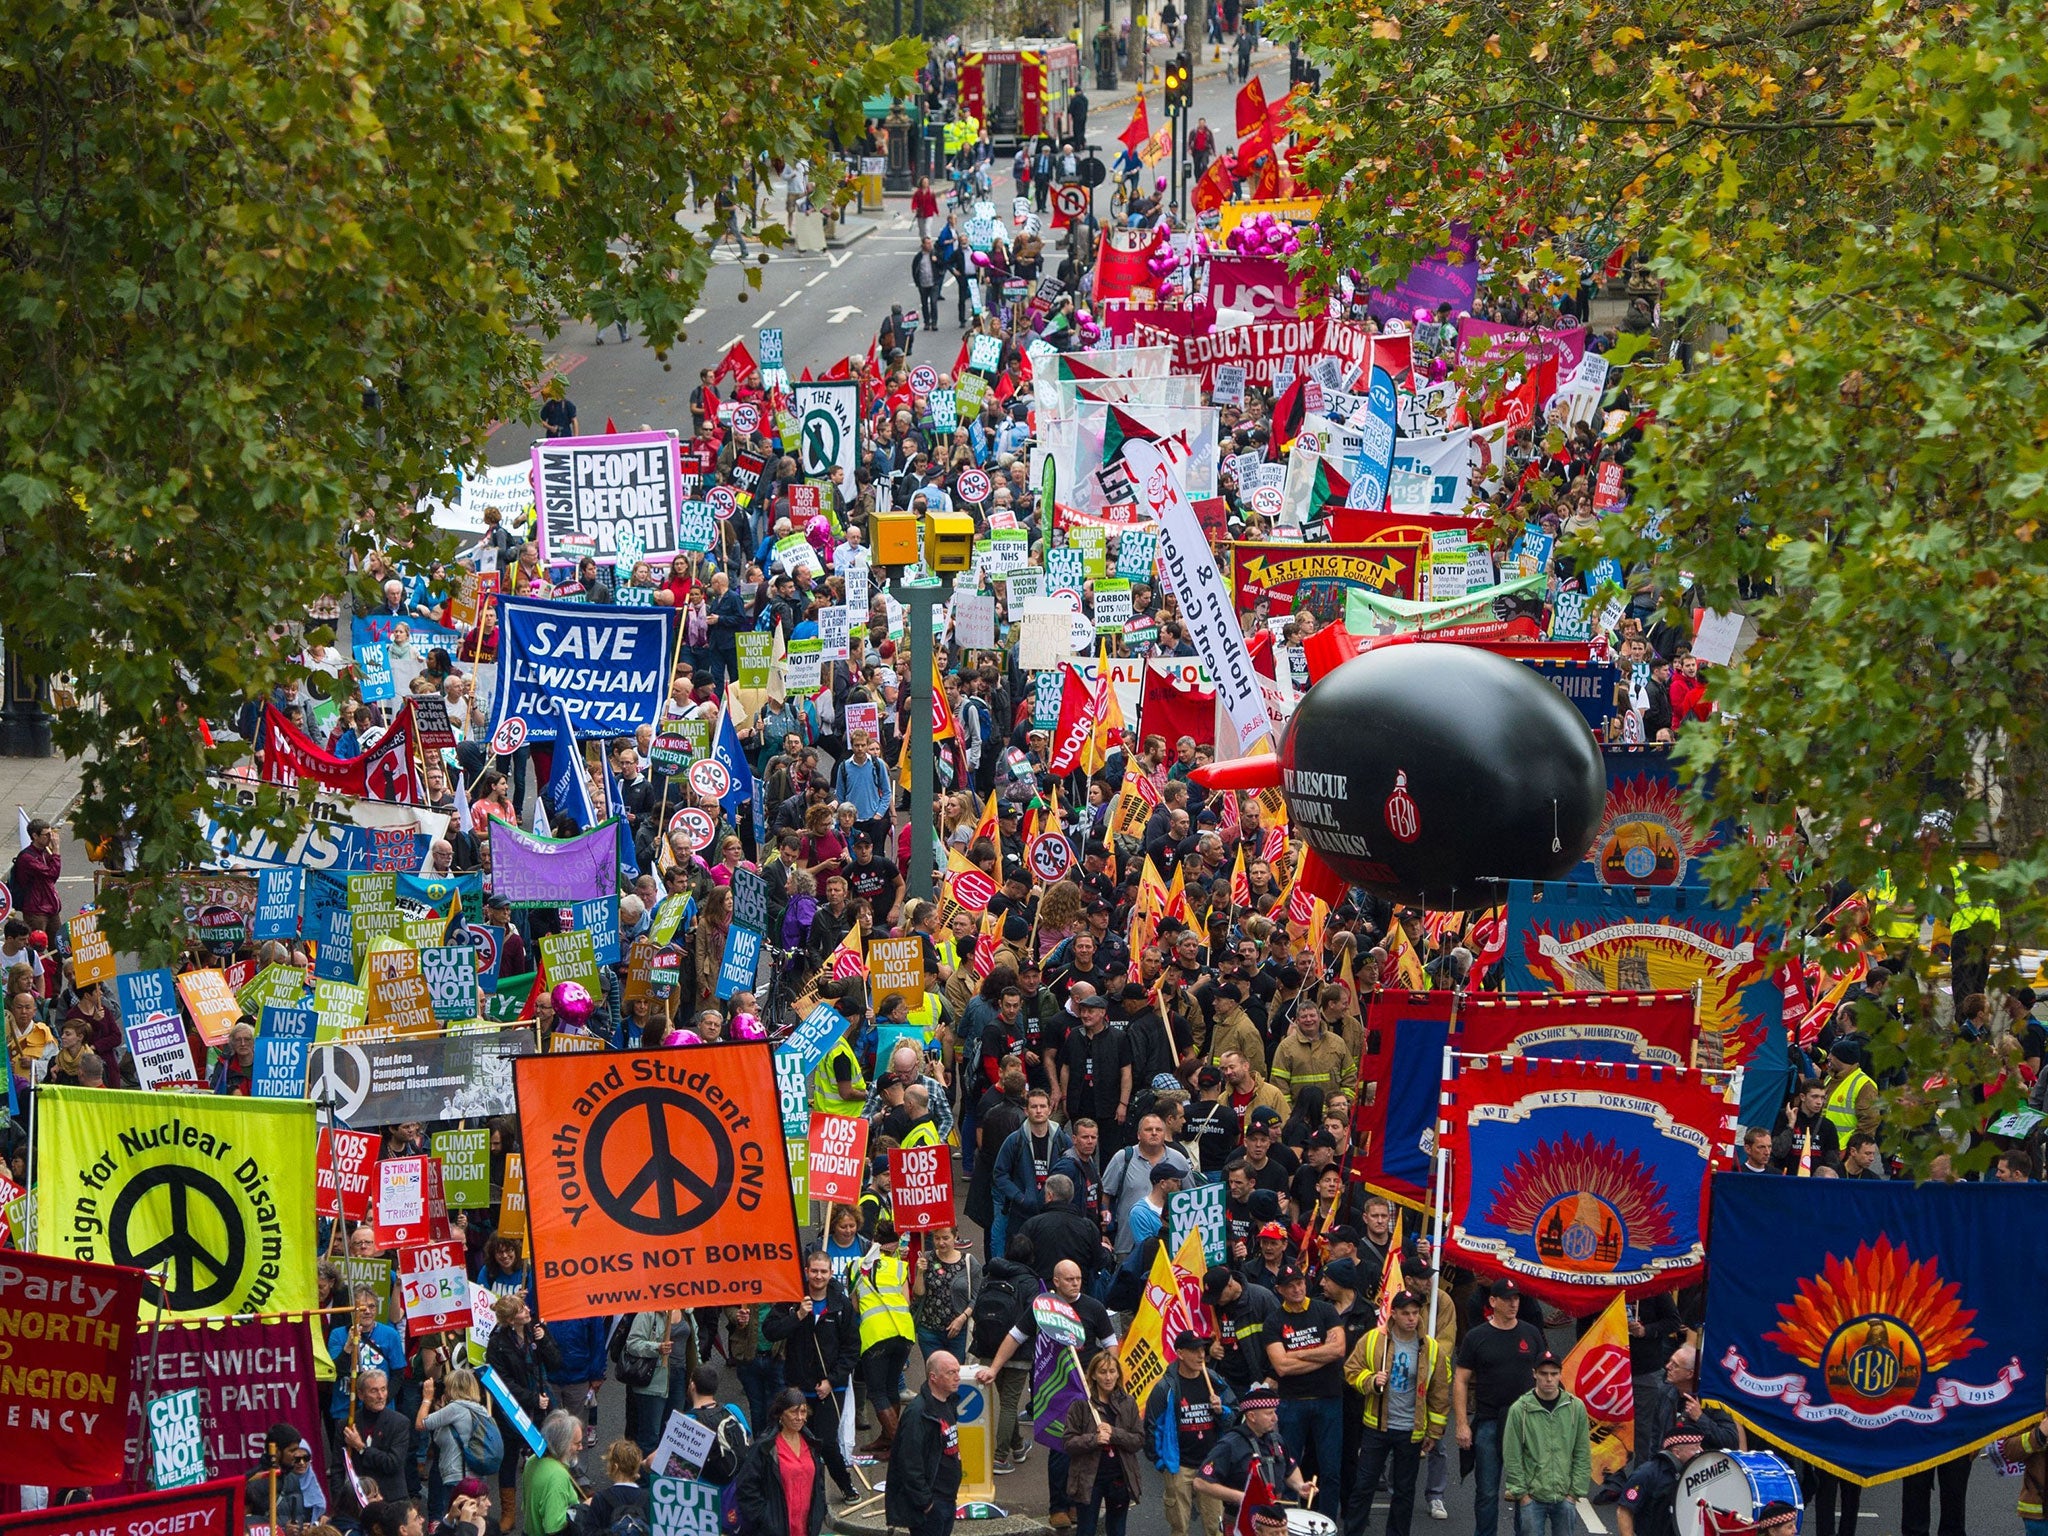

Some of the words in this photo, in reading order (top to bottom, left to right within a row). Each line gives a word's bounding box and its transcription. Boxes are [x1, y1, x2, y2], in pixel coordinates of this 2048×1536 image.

[1213, 284, 1302, 318] UCU
[1184, 323, 1314, 363] EDUCATION
[1321, 321, 1367, 360] NOW
[929, 390, 956, 402] CUT
[811, 391, 832, 405] THE
[833, 399, 851, 437] WAR
[577, 449, 665, 486] PEOPLE
[963, 482, 986, 496] CUTS
[964, 475, 980, 486] NO
[578, 485, 667, 519] BEFORE
[794, 487, 814, 499] JOBS
[543, 453, 573, 557] LEWISHAM
[682, 501, 714, 516] CUT
[682, 514, 713, 527] WAR
[1071, 529, 1103, 540] CLIMATE
[1122, 531, 1156, 548] CUT
[992, 543, 1011, 552] KEEP
[1012, 542, 1026, 552] THE
[1047, 549, 1082, 563] CUT
[1121, 543, 1154, 560] WAR
[1000, 552, 1019, 562] NHS
[1119, 555, 1151, 570] NOT
[1048, 562, 1083, 575] WAR
[1268, 556, 1384, 578] ISLINGTON
[1432, 568, 1446, 578] NO
[1447, 567, 1465, 577] TTIP
[1012, 578, 1038, 588] WORK
[1269, 571, 1303, 587] TRADES
[1307, 568, 1339, 578] UNION
[1342, 570, 1379, 587] COUNCIL
[1012, 587, 1038, 598] TODAY
[1096, 594, 1130, 604] CARBON
[1268, 590, 1293, 603] WORKERS
[1439, 630, 1456, 638] the
[1457, 620, 1509, 637] alternative
[529, 622, 638, 660] SAVE
[362, 646, 384, 664] NHS
[789, 655, 803, 665] NO
[804, 653, 820, 664] TTIP
[514, 659, 658, 693] LEWISHAM
[515, 692, 644, 722] HOSPITAL
[418, 719, 449, 732] Out!
[667, 722, 706, 736] CLIMATE
[497, 731, 518, 748] CUTS
[655, 738, 667, 748] NO
[669, 740, 689, 750] MORE
[650, 747, 692, 766] AUSTERITY
[701, 764, 722, 779] NO
[694, 774, 725, 792] CUTS
[1297, 771, 1348, 800] RESCUE
[1291, 798, 1341, 830] PEOPLE,
[1389, 796, 1417, 838] FBU
[375, 828, 416, 846] NOT
[1313, 829, 1372, 858] BANKS!
[377, 842, 414, 860] FOR
[1043, 841, 1063, 853] NO
[1035, 852, 1066, 869] CUTS
[268, 872, 293, 893] NHS
[351, 876, 393, 892] CLIMATE
[268, 891, 289, 904] NOT
[260, 903, 296, 921] TRIDENT
[355, 913, 400, 931] CLIMATE
[200, 927, 245, 940] AUSTERITY
[734, 930, 757, 953] NHS
[1541, 939, 1588, 957] NORTH
[1591, 924, 1663, 945] YORKSHIRE
[1668, 926, 1696, 941] FIRE
[1698, 938, 1750, 962] BRIGADE
[543, 935, 588, 955] CLIMATE
[873, 939, 919, 961] HOMES
[421, 949, 474, 966] CUT
[555, 951, 580, 964] NOT
[732, 952, 753, 967] NOT
[884, 958, 910, 974] NOT
[422, 965, 474, 984] WAR
[548, 961, 594, 983] TRIDENT
[651, 970, 680, 984] AUSTERITY
[723, 963, 755, 987] TRIDENT
[875, 970, 920, 989] TRIDENT
[129, 973, 164, 999] NHS
[185, 971, 222, 995] HOMES
[377, 980, 424, 1004] HOMES
[319, 984, 364, 1002] CLIMATE
[135, 998, 162, 1012] NOT
[195, 998, 238, 1018] TRIDENT
[391, 999, 417, 1013] NOT
[806, 1004, 840, 1031] NHS
[137, 1022, 175, 1039] Justice
[138, 1034, 180, 1052] Alliance
[1516, 1028, 1568, 1049] YORKSHIRE
[1583, 1028, 1639, 1044] HUMBERSIDE
[1646, 1047, 1679, 1064] REGION
[142, 1050, 185, 1068] Fighting
[266, 1041, 302, 1070] NHS
[373, 1058, 391, 1068] Kent
[392, 1056, 412, 1066] Area
[158, 1065, 174, 1080] for
[175, 1069, 192, 1083] aid
[268, 1067, 297, 1080] NOT
[373, 1066, 415, 1082] Campaign
[416, 1065, 429, 1075] for
[257, 1078, 305, 1097] TRIDENT
[372, 1081, 405, 1092] Nuclear
[406, 1075, 465, 1089] Disarmament
[1540, 1092, 1578, 1105] WEST
[1598, 1093, 1658, 1113] YORKSHIRE
[1669, 1125, 1705, 1146] REGION
[820, 1117, 857, 1142] JOBS
[1187, 1123, 1224, 1137] Firefighters
[329, 1133, 368, 1159] JOBS
[435, 1133, 486, 1154] CLIMATE
[552, 1123, 590, 1228] Youth
[573, 1065, 624, 1117] and
[631, 1059, 751, 1133] Student
[737, 1141, 766, 1212] CND
[823, 1140, 852, 1156] NOT
[79, 1150, 118, 1191] for
[117, 1118, 234, 1162] Nuclear
[446, 1151, 475, 1166] NOT
[901, 1149, 938, 1173] JOBS
[384, 1163, 420, 1177] STIRLING
[811, 1153, 859, 1177] TRIDENT
[905, 1172, 936, 1187] NOT
[896, 1184, 948, 1206] TRIDENT
[1172, 1186, 1223, 1213] CUT
[384, 1207, 420, 1222] TRIDENT
[1172, 1206, 1223, 1232] WAR
[414, 1246, 453, 1274] JOBS
[545, 1252, 634, 1279] BOOKS
[642, 1248, 697, 1269] NOT
[706, 1243, 794, 1264] BOMBS
[1519, 1263, 1542, 1277] FIRE
[1551, 1271, 1607, 1286] BRIGADES
[1615, 1271, 1652, 1285] UNION
[0, 1265, 117, 1317] Party
[586, 1279, 763, 1307] www.YSCND.org
[1852, 1350, 1896, 1392] FBU
[222, 1381, 301, 1412] PARTY
[1739, 1375, 1784, 1393] FOUNDED
[1805, 1409, 1824, 1420] THE
[1828, 1408, 1850, 1418] FIRE
[1851, 1411, 1898, 1427] BRIGADES
[1901, 1409, 1934, 1421] UNION
[1968, 1389, 1996, 1402] 1918
[151, 1390, 197, 1427] CUT
[153, 1415, 199, 1450] WAR
[666, 1434, 687, 1453] roses,
[688, 1446, 703, 1460] too!
[156, 1439, 202, 1475] NOT
[158, 1461, 203, 1485] WELFARE
[1684, 1458, 1730, 1496] PREMIER
[653, 1480, 719, 1509] CUT
[127, 1508, 216, 1536] SOCIETY
[655, 1502, 719, 1531] WAR
